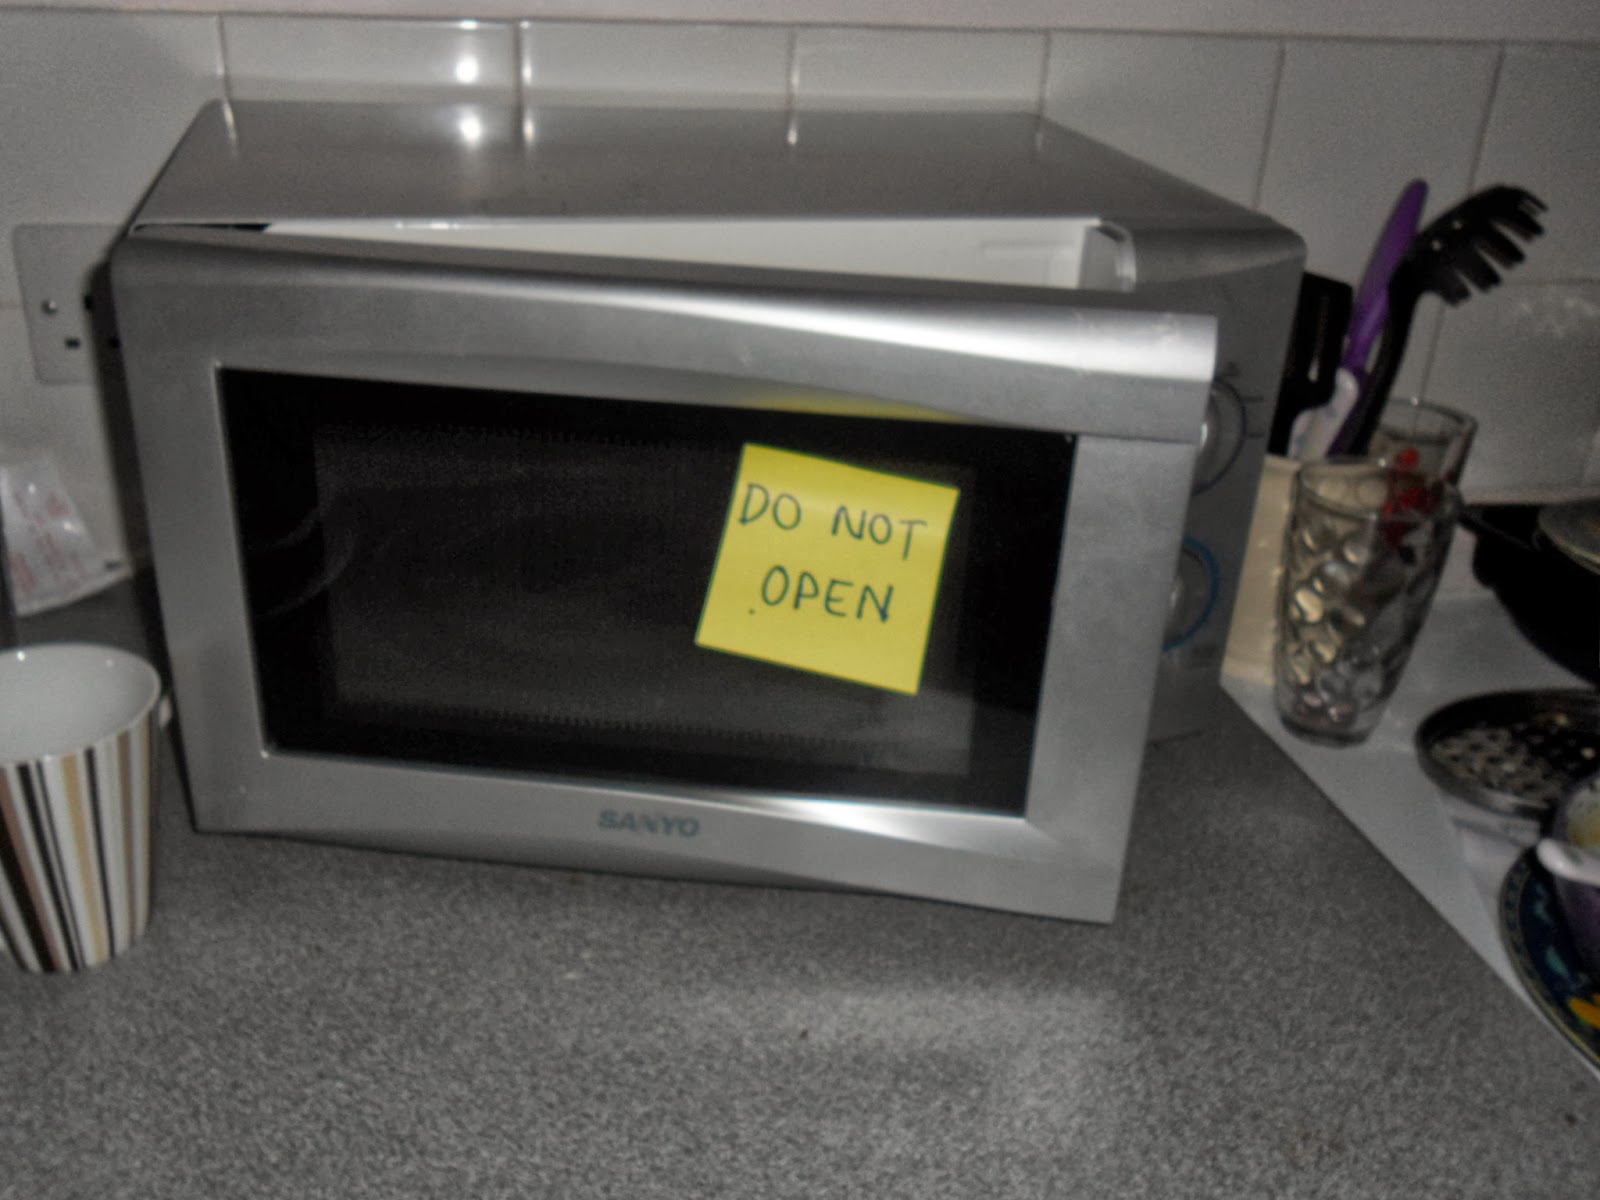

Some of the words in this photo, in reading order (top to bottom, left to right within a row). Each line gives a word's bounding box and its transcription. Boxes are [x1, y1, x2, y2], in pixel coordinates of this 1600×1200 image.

[738, 482, 802, 531] DO
[831, 504, 928, 561] NOT
[761, 564, 894, 624] OPEN
[598, 808, 700, 838] SANYO
